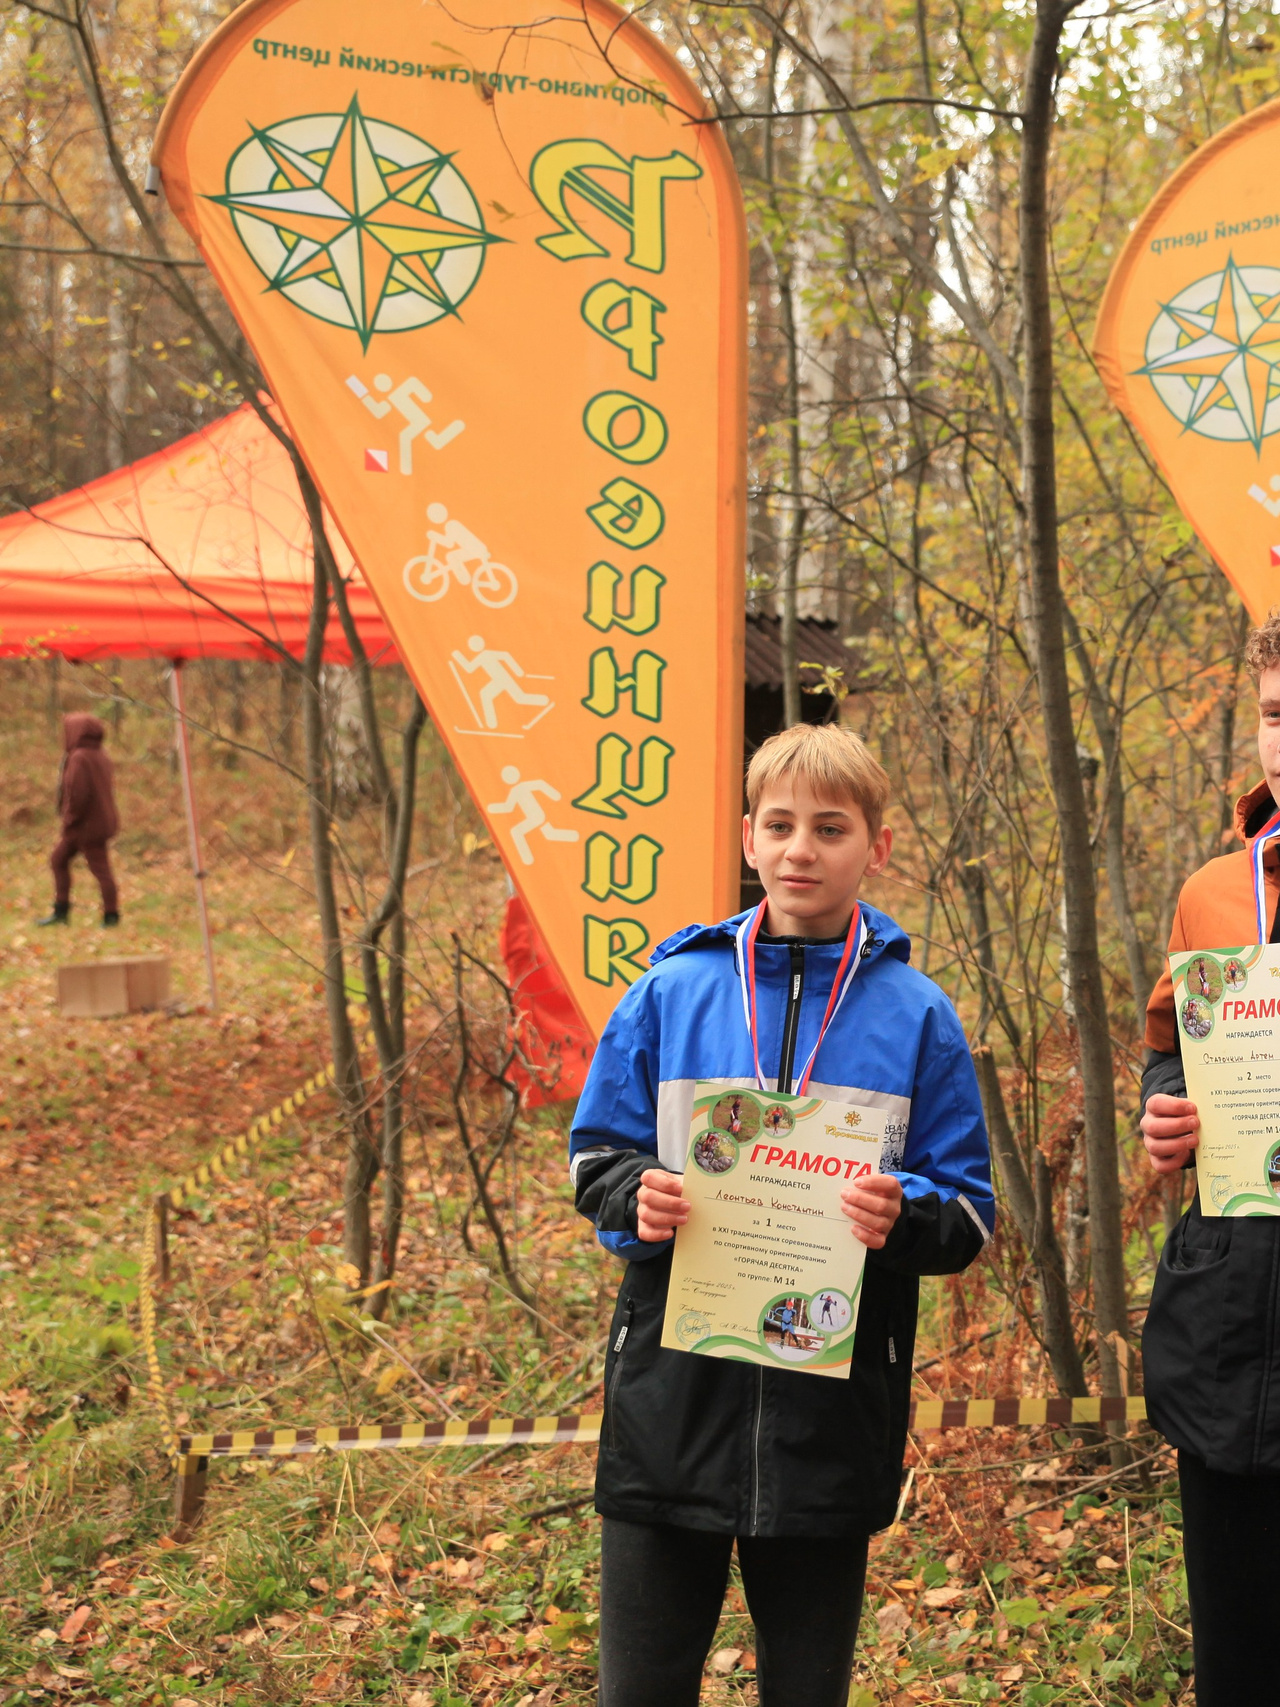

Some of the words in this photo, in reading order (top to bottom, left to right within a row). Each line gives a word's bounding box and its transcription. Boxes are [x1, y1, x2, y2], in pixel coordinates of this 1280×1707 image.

[1226, 1029, 1273, 1039] НАГРАЖДАЕТСЯ
[1246, 1072, 1252, 1080] 2
[1223, 1088, 1262, 1096] традиционных
[1266, 1126, 1273, 1134] М
[750, 1144, 872, 1180] ГРАМОТА
[750, 1174, 811, 1190] НАГРАЖДАЕТСЯ
[716, 1190, 764, 1206] Леонтьев
[771, 1197, 824, 1216] Константин
[766, 1218, 772, 1227] 1
[776, 1223, 796, 1231] место
[718, 1226, 730, 1234] XXI
[730, 1229, 780, 1243] традиционных
[781, 1237, 832, 1251] соревнованиях
[724, 1242, 768, 1255] спортивному
[769, 1249, 827, 1264] ориентированию
[734, 1256, 769, 1267] «ГОРЯЧАЯ
[769, 1262, 804, 1273] ДЕСЯТКА»
[747, 1274, 772, 1283] группе:
[773, 1276, 783, 1284] М
[785, 1278, 795, 1286] 14
